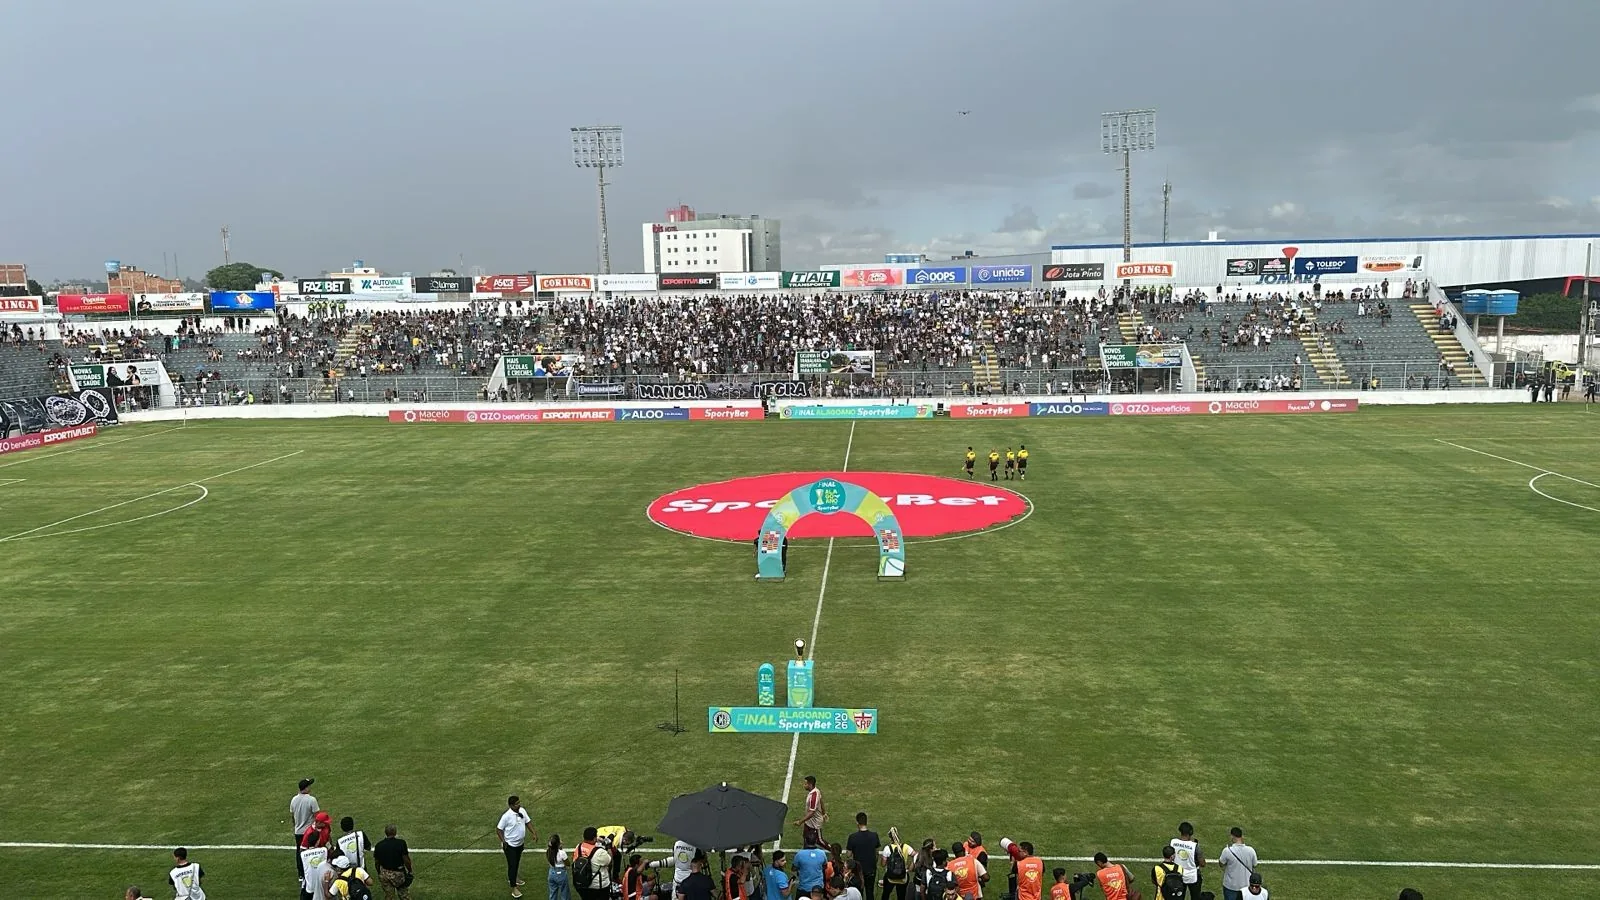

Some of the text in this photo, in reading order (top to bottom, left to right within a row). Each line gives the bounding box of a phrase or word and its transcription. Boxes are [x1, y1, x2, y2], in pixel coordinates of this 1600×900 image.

[992, 267, 1025, 277] unidos
[1064, 270, 1102, 279] Jota Pinto
[1120, 265, 1169, 276] CORINGA
[790, 272, 834, 283] TAL
[929, 271, 955, 281] OOPS
[543, 278, 588, 288] CORINGA
[82, 379, 101, 387] SAÚDE
[639, 385, 708, 399] MANCHA
[1047, 404, 1082, 414] ALOO
[1225, 400, 1259, 409] Maceió
[419, 410, 449, 419] Maceió
[631, 410, 664, 419] ALOO
[704, 408, 749, 419] SportyBet
[857, 406, 899, 418] SportyBet
[966, 405, 1012, 417] SportyBet
[736, 714, 776, 726] FINAL
[778, 711, 832, 719] ALAGOANO
[834, 713, 848, 721] 20
[778, 718, 832, 730] SportyBet
[834, 721, 848, 729] 26
